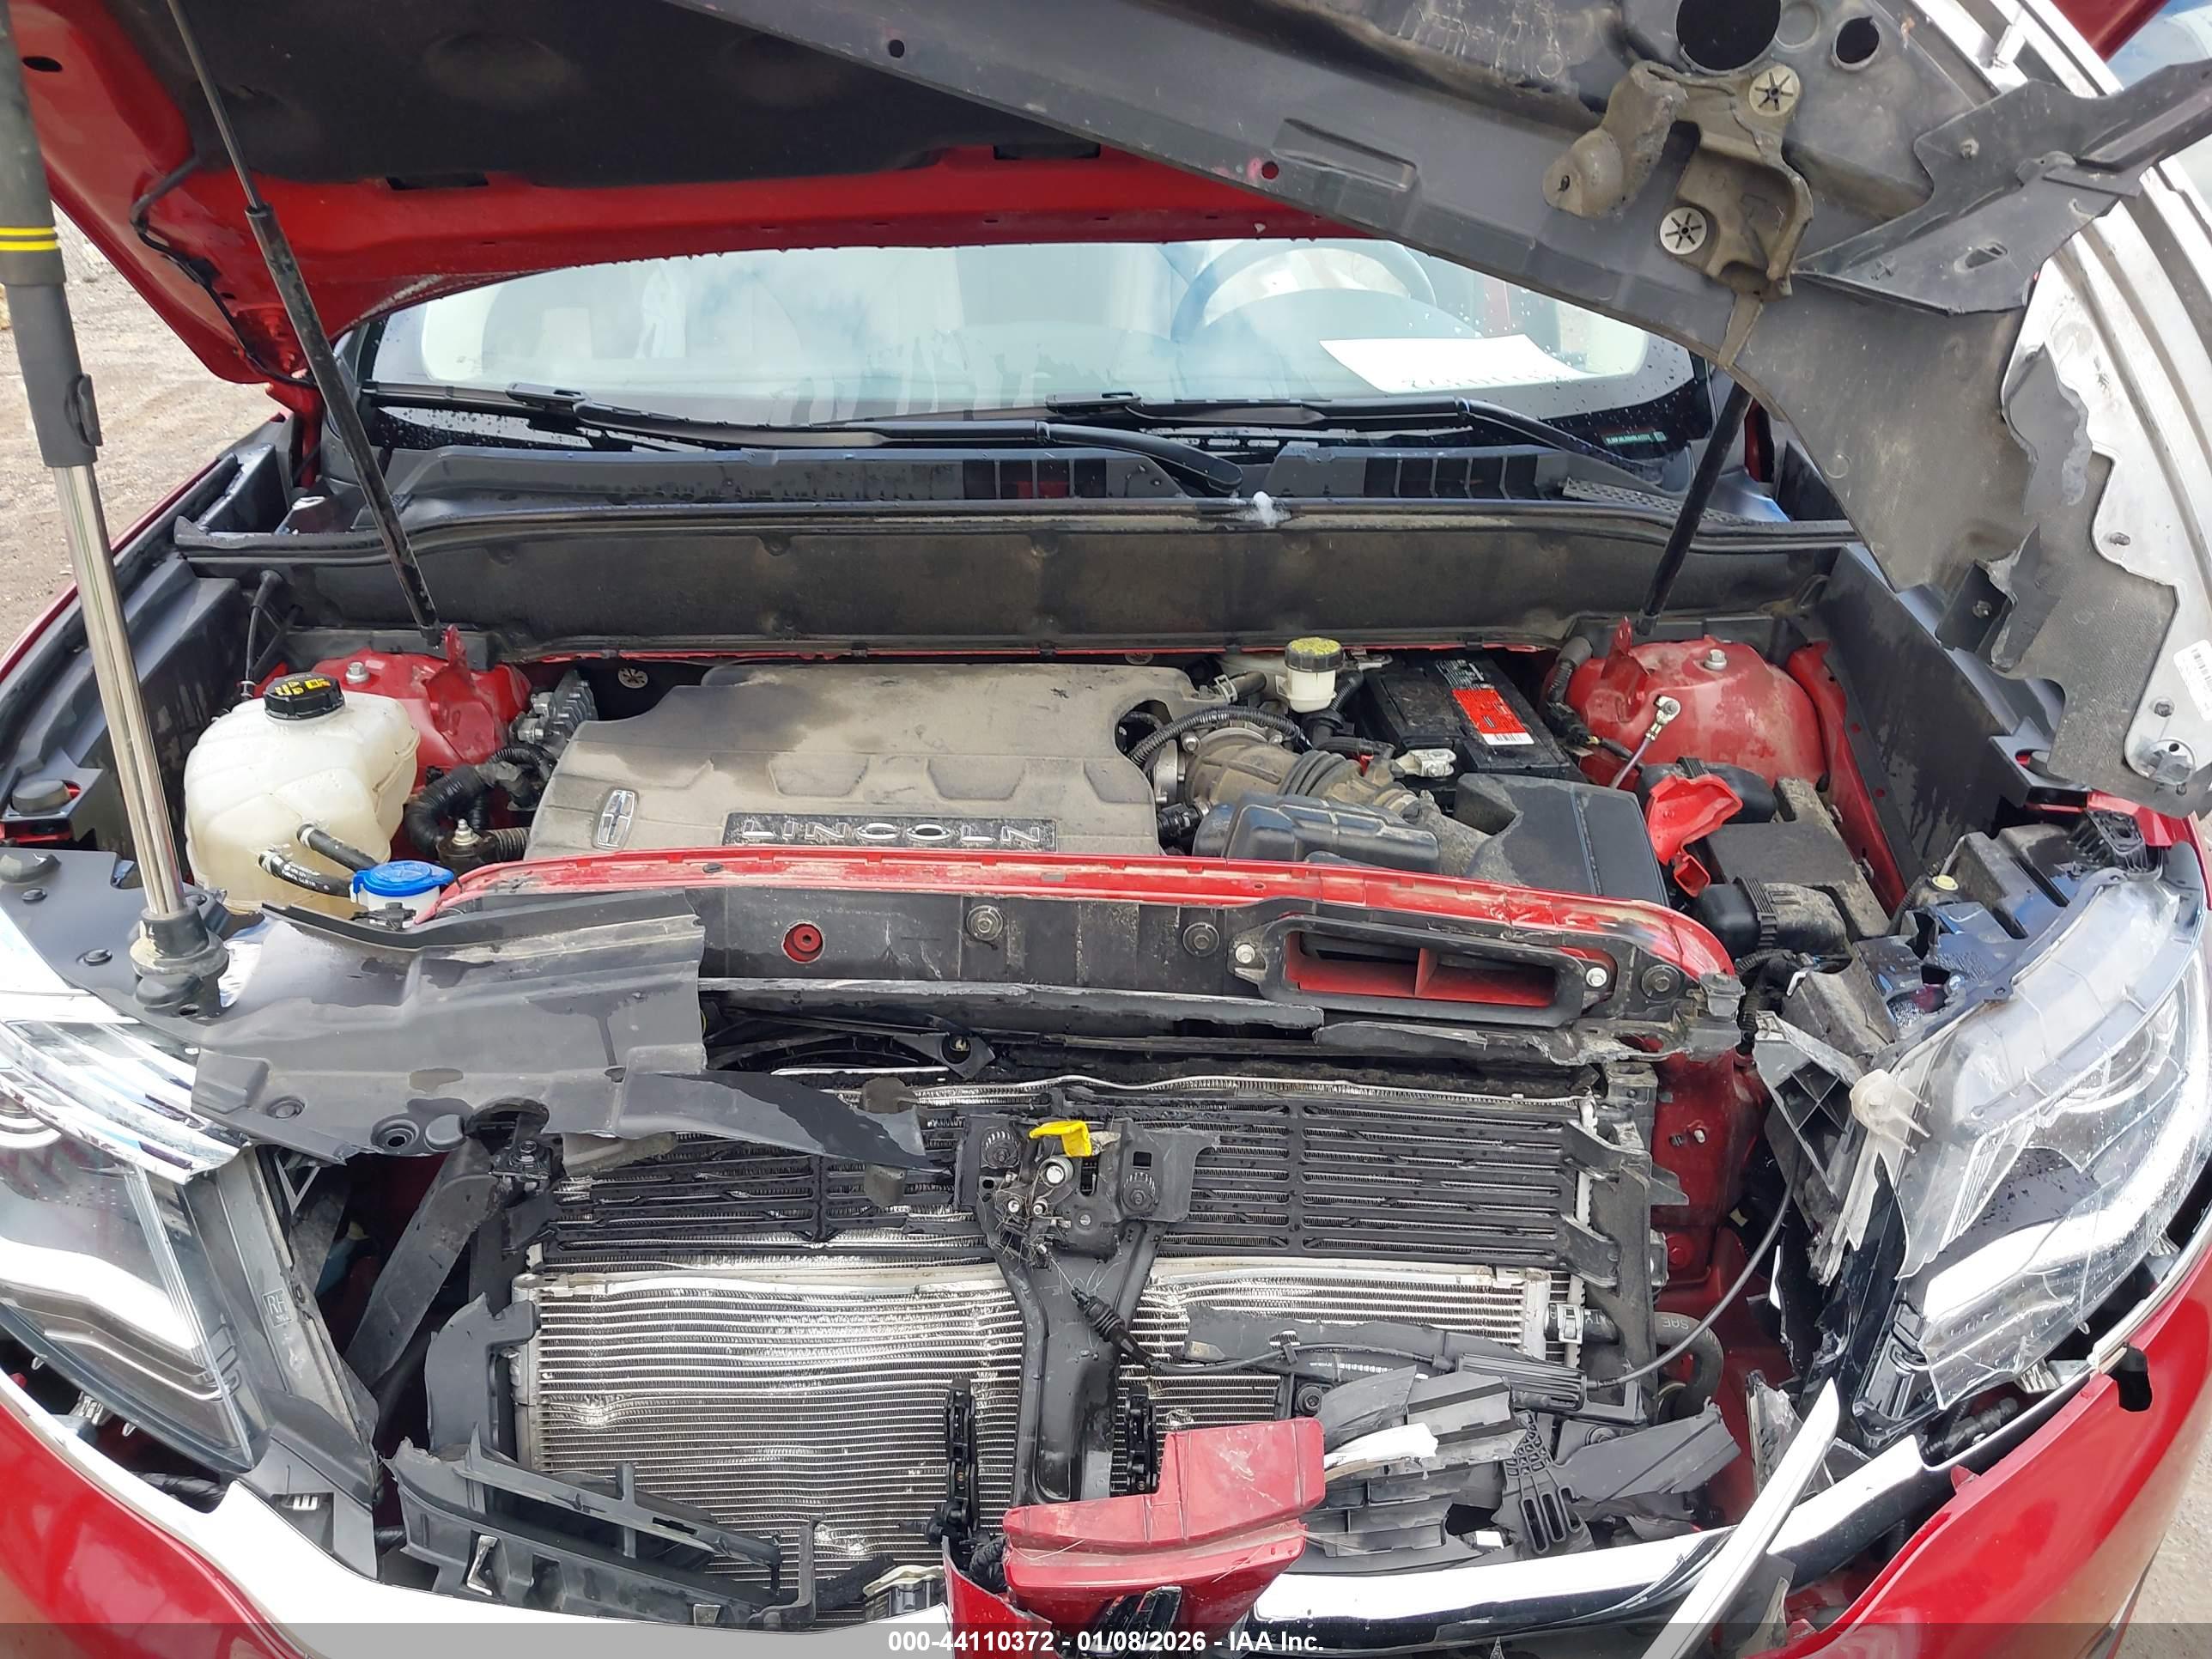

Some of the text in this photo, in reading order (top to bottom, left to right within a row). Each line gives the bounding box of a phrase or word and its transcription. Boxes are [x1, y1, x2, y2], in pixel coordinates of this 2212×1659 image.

[741, 817, 1041, 844] LINCOLN
[267, 1294, 288, 1315] RH
[1662, 1316, 1689, 1330] SAE
